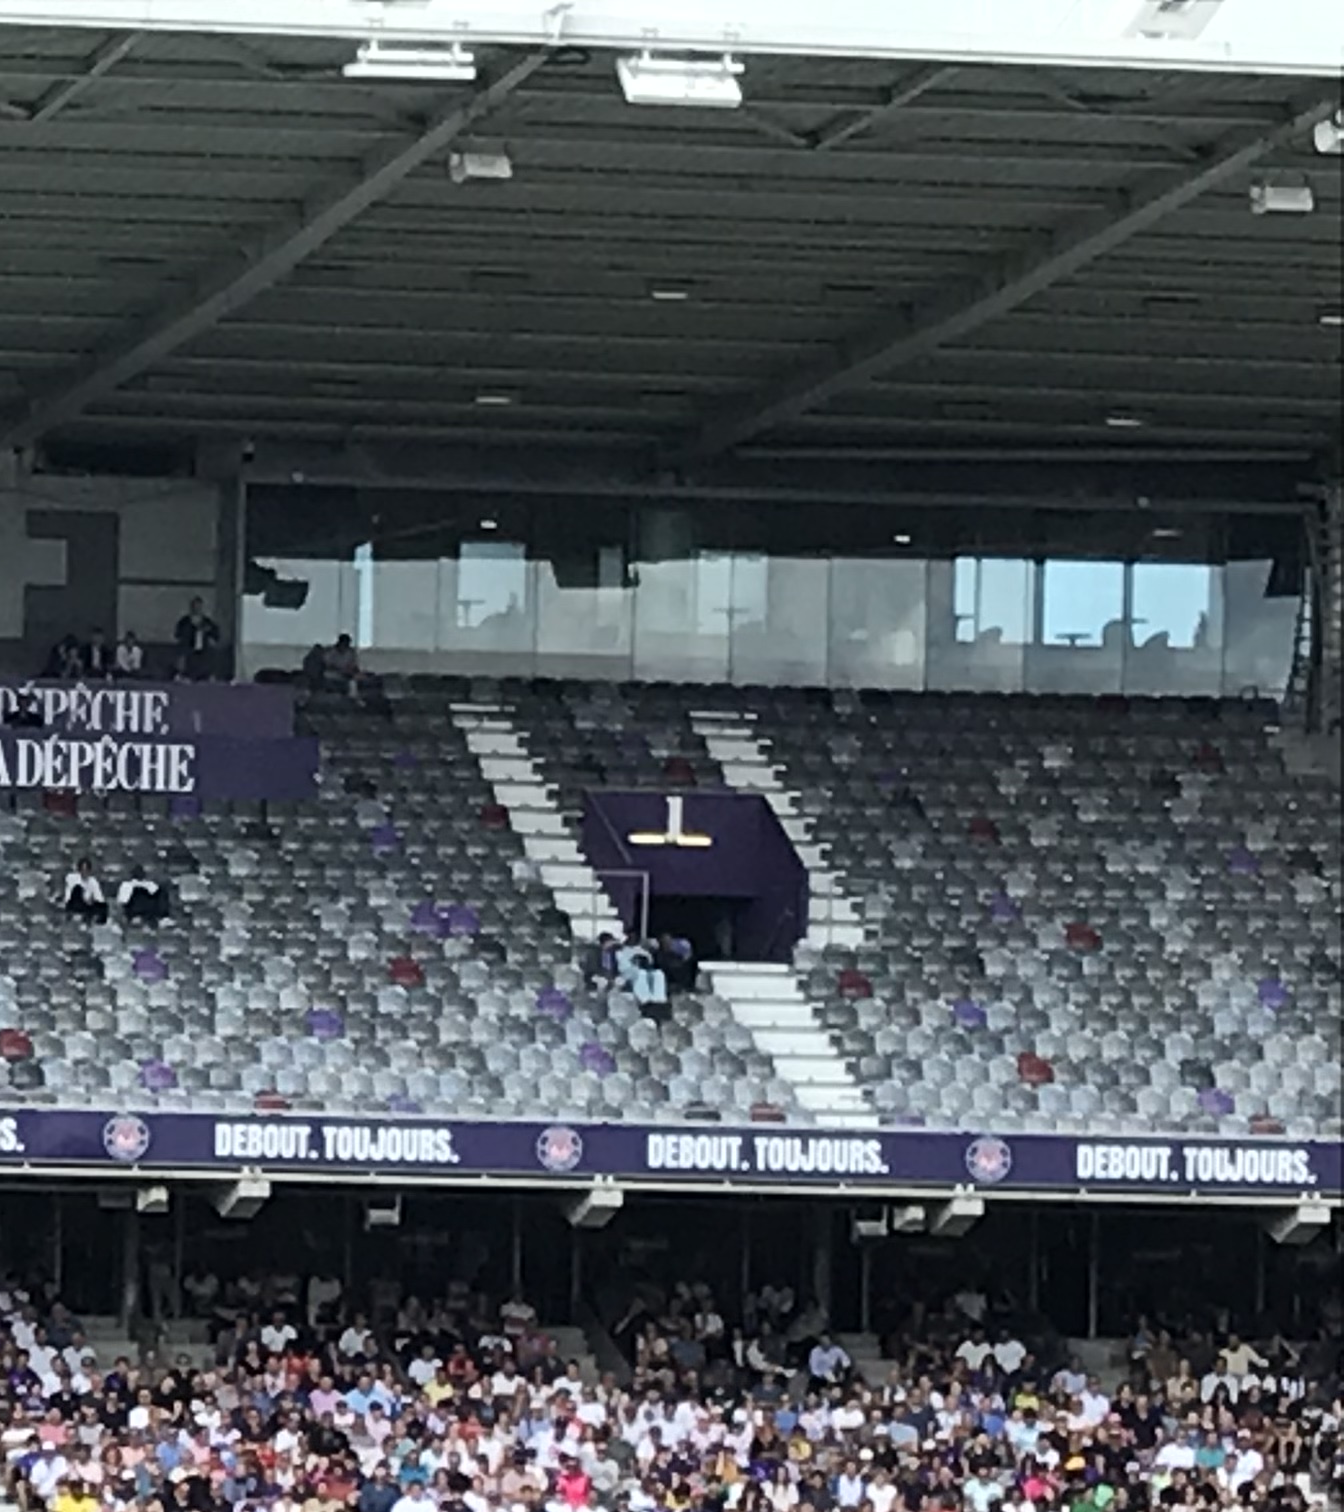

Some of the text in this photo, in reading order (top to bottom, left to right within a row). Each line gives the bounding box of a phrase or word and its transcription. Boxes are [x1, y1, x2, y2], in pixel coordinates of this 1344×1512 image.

[16, 734, 195, 793] DÉPÊCHE
[666, 795, 685, 843] 1
[215, 1123, 460, 1163] DEBOUT. TOUJOURS.
[647, 1133, 889, 1174] DEBOUT. TOUJOURS.
[1077, 1145, 1317, 1184] DEBOUT. TOUJOURS.
